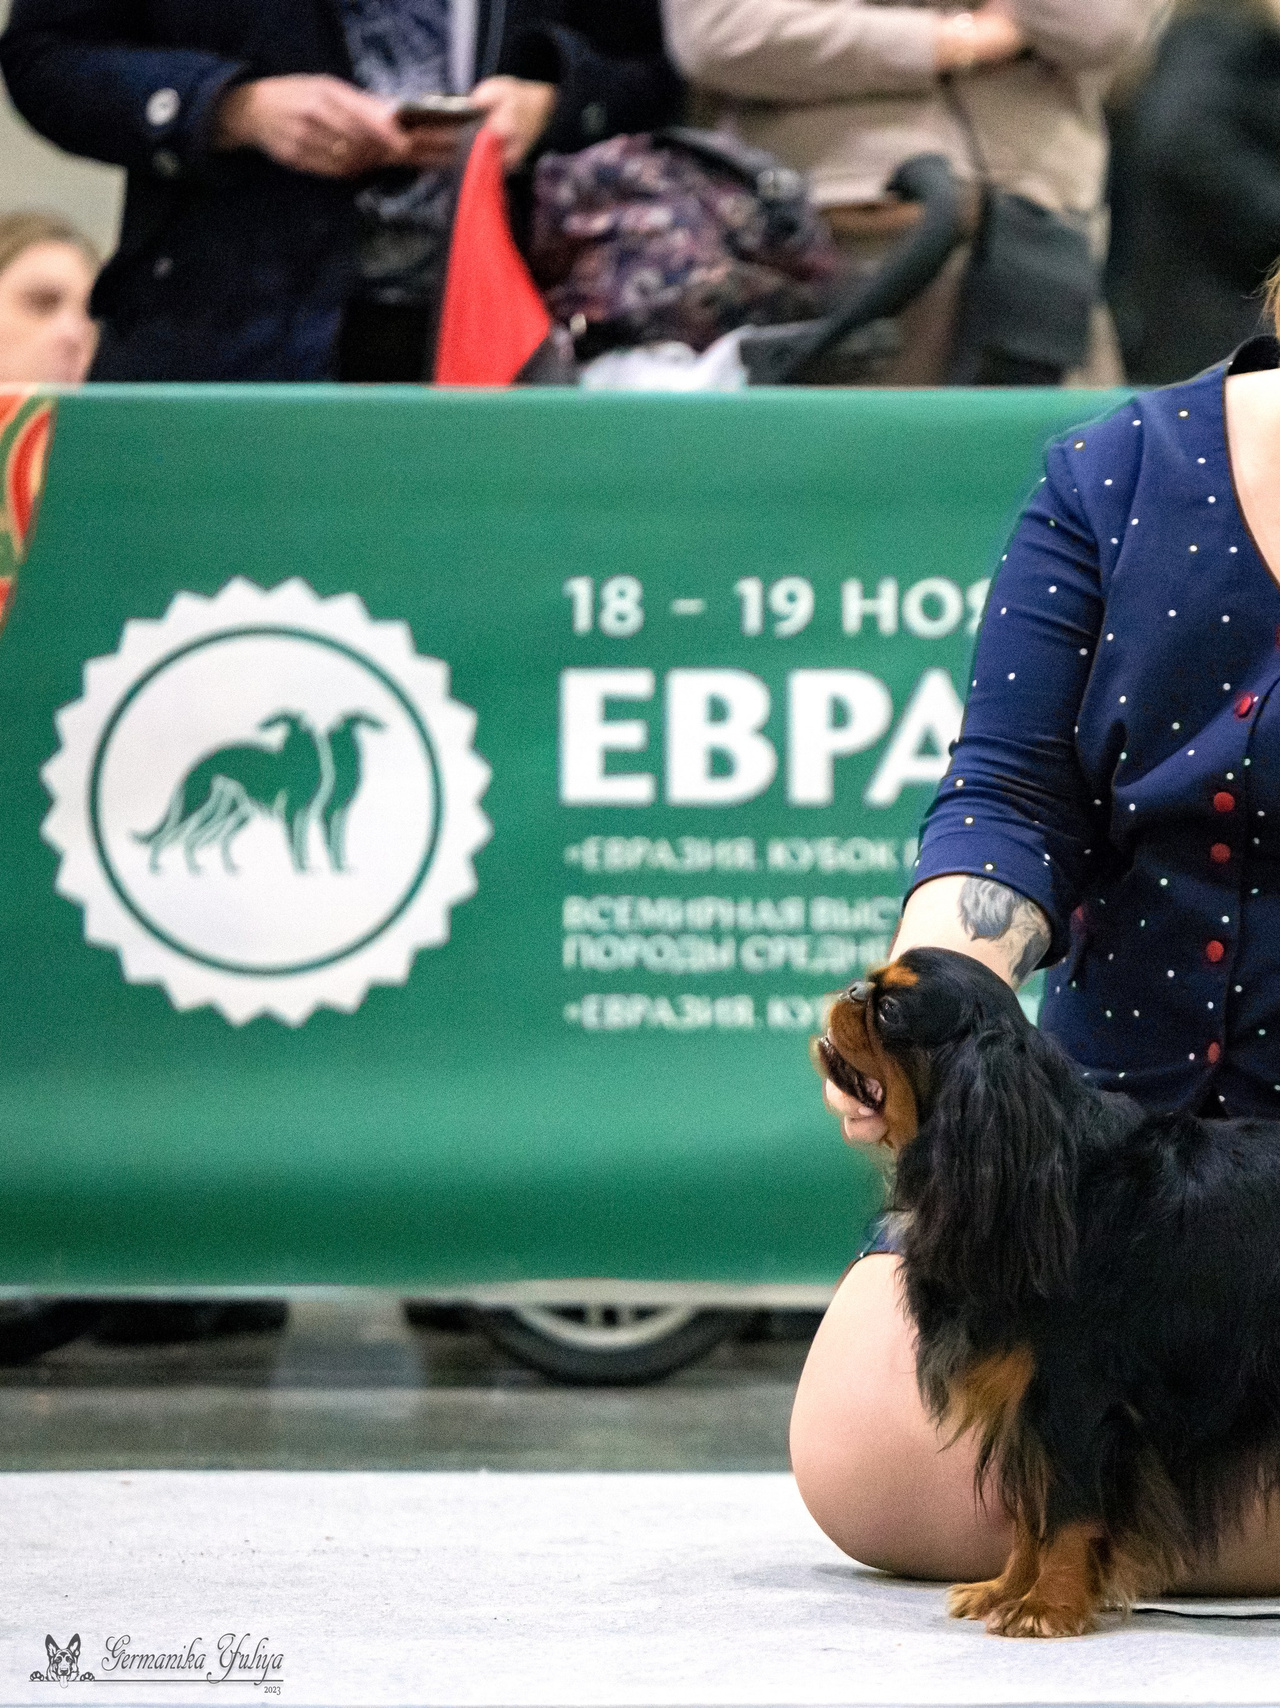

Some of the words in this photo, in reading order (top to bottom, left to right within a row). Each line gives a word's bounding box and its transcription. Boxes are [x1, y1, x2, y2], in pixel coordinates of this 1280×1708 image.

[563, 575, 644, 638] 18
[735, 575, 814, 638] 19
[559, 666, 966, 806] ЕВРА
